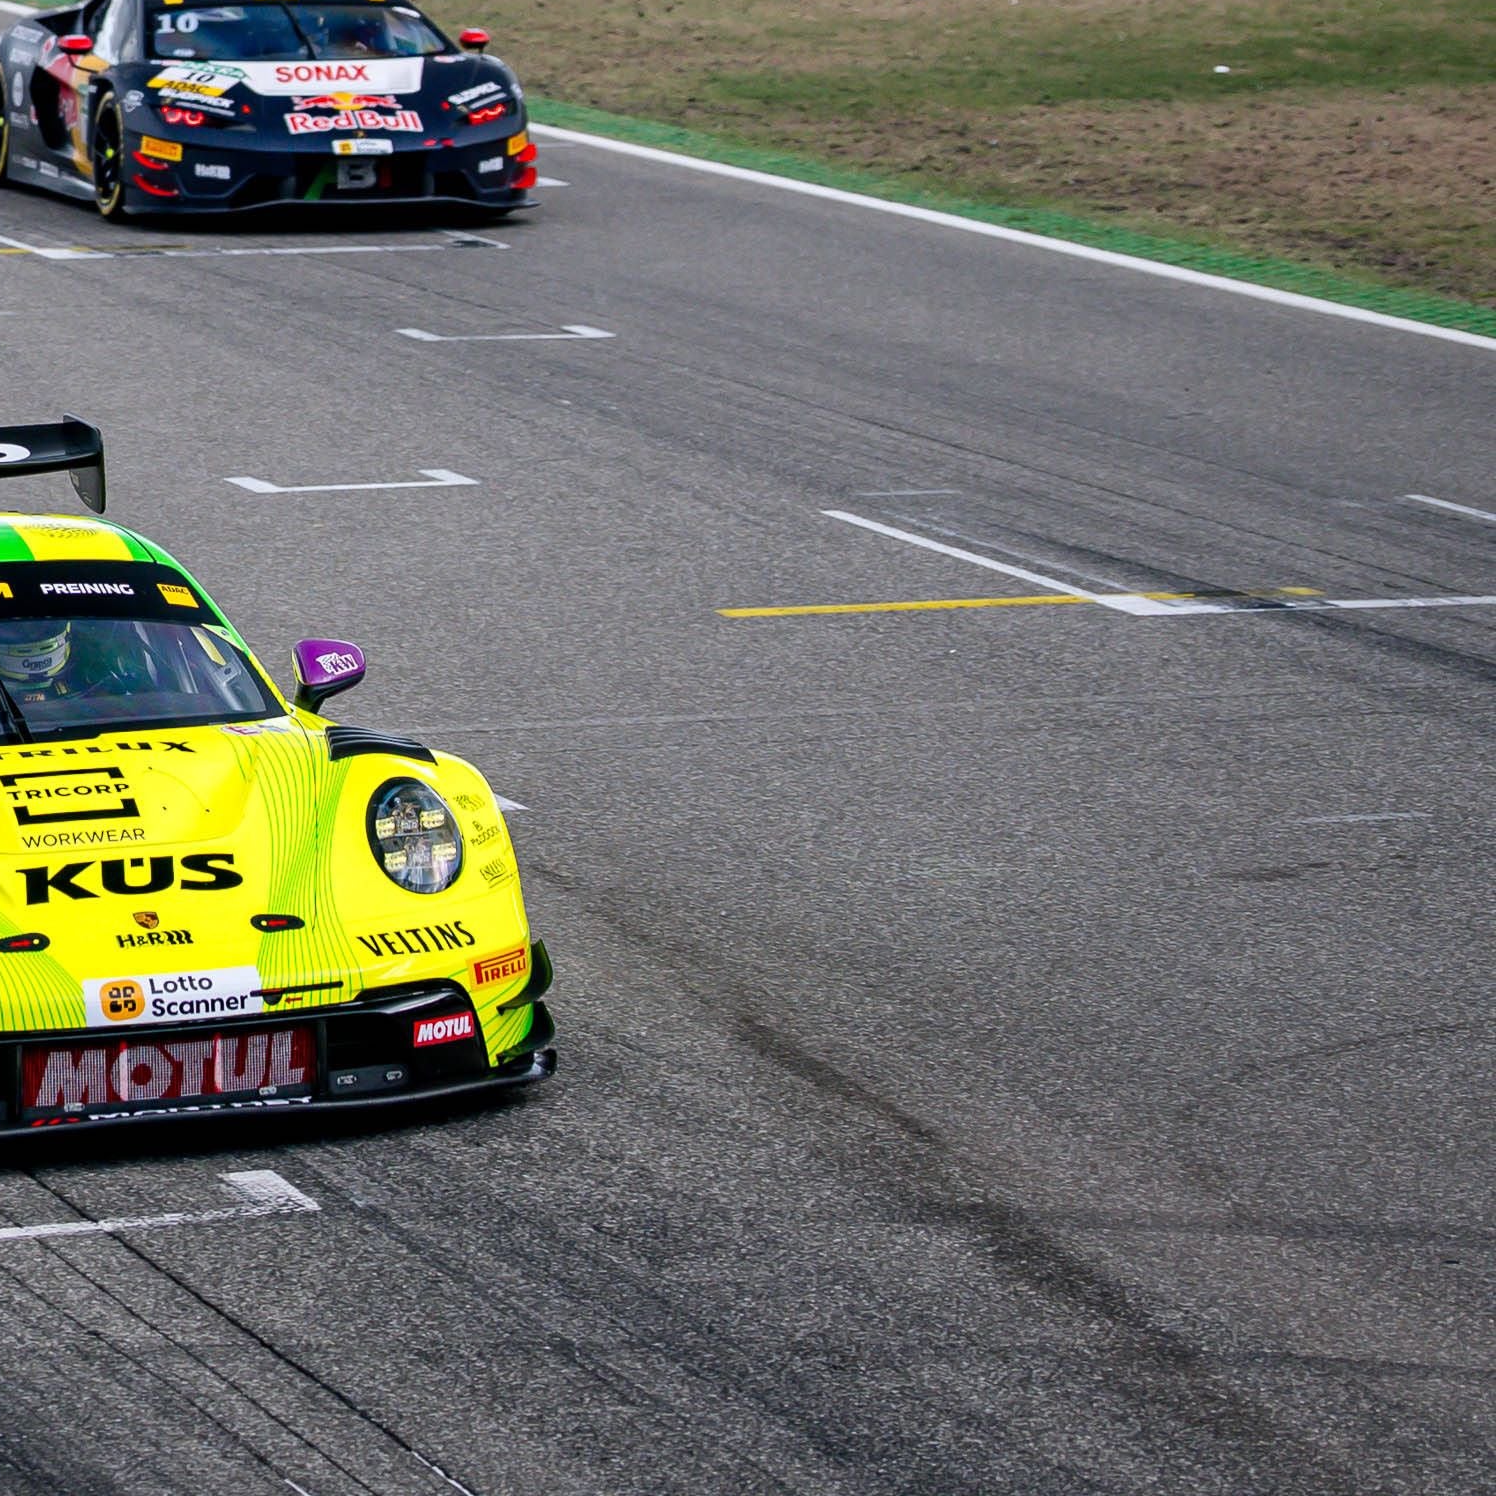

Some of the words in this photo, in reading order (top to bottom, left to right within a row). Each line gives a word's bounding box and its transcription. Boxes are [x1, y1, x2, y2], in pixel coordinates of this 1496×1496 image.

[157, 12, 199, 34] 10
[184, 72, 215, 83] 10
[275, 64, 371, 83] SONAX
[288, 111, 352, 132] Red
[358, 110, 422, 132] Bull
[39, 582, 135, 596] PREINING
[160, 584, 190, 596] ADAC
[329, 655, 356, 673] KW
[7, 783, 130, 801] TRICORP
[22, 829, 145, 849] WORKWEAR
[16, 853, 244, 906] KÜS
[116, 930, 172, 948] H&R
[357, 920, 476, 957] VELTINS
[473, 948, 527, 985] PIRELLI
[148, 974, 213, 993] Lotto
[151, 990, 249, 1018] Scanner
[416, 1015, 472, 1043] MOTUL
[35, 1031, 307, 1108] MOTUL
